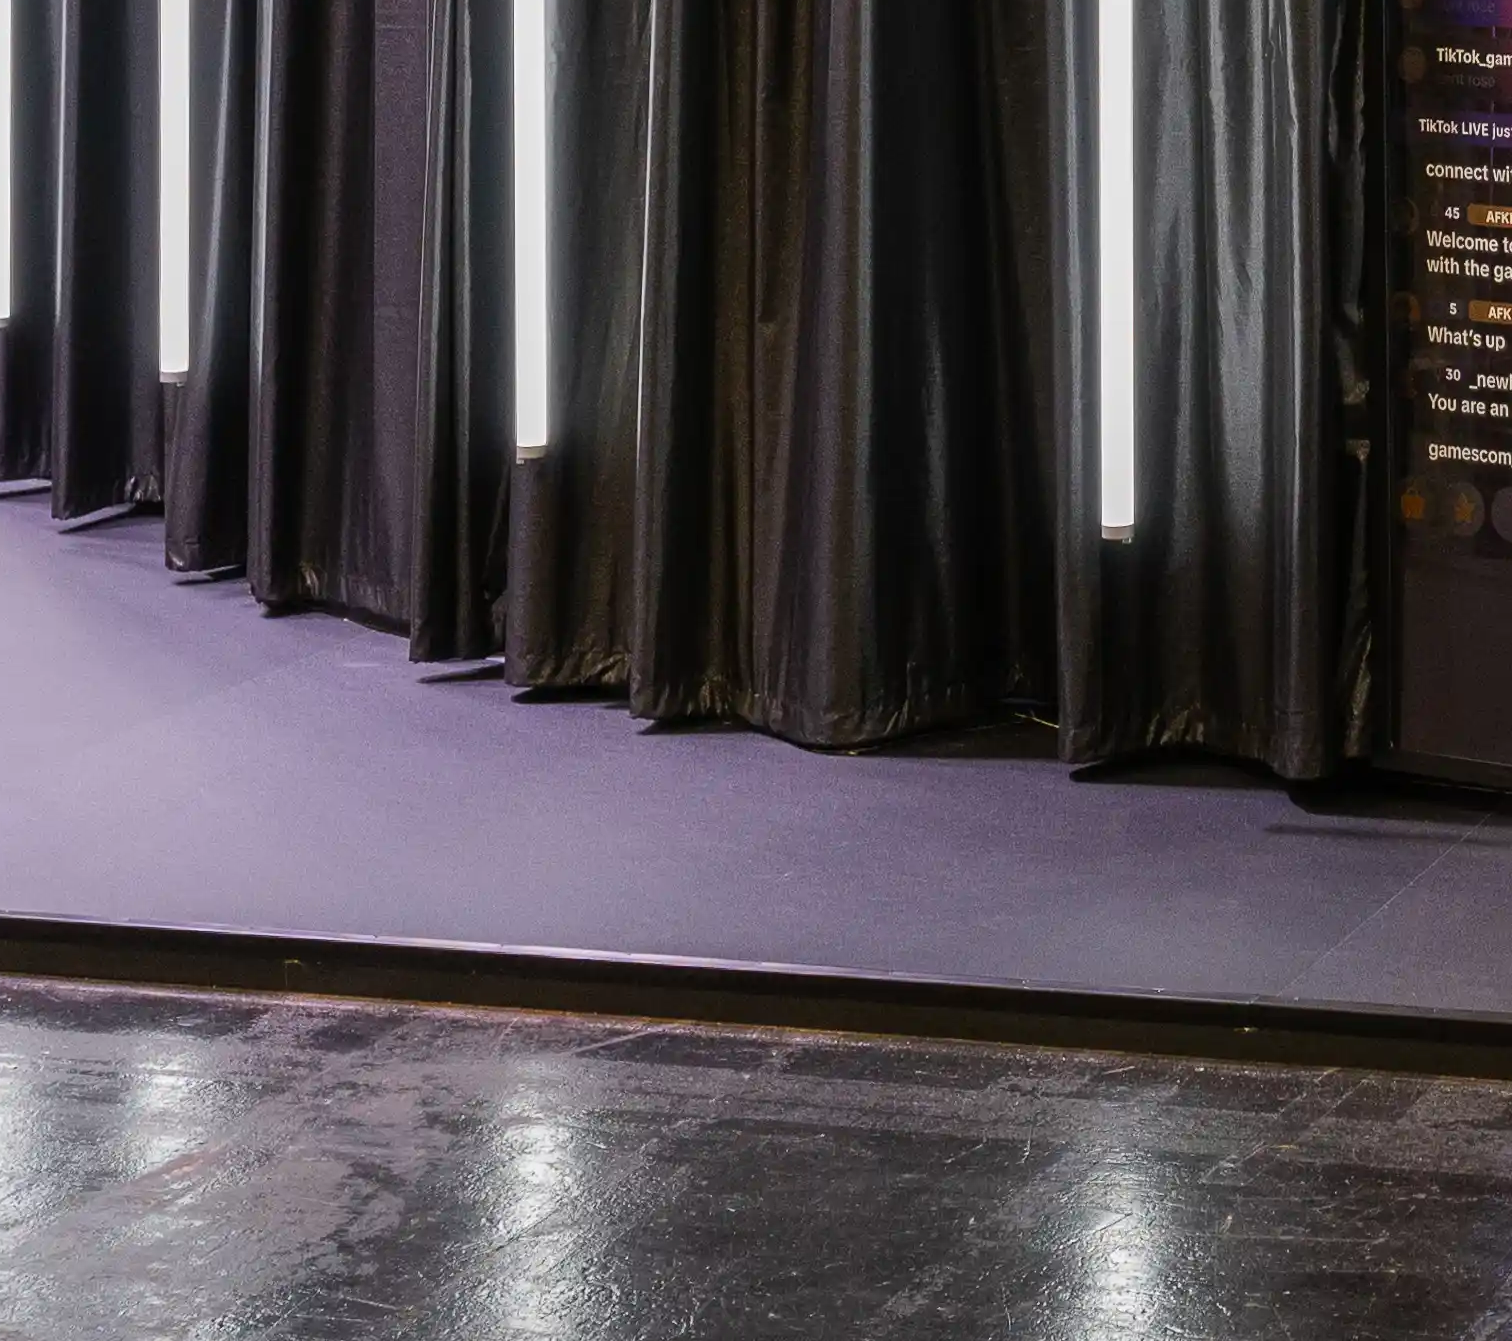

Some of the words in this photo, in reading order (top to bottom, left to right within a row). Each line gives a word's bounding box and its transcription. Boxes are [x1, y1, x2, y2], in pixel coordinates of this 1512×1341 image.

[1419, 118, 1459, 134] TikTok
[1462, 121, 1489, 137] LIVE
[1426, 163, 1489, 182] connect
[1445, 207, 1460, 219] 45
[1427, 230, 1498, 252] Welcome
[1427, 257, 1460, 275] with
[1464, 260, 1489, 278] the
[1450, 303, 1457, 315] 5
[1428, 326, 1482, 347] What's
[1485, 334, 1505, 351] up
[1446, 369, 1461, 382] 30
[1428, 393, 1457, 412] You
[1461, 399, 1485, 415] are
[1491, 401, 1508, 417] an
